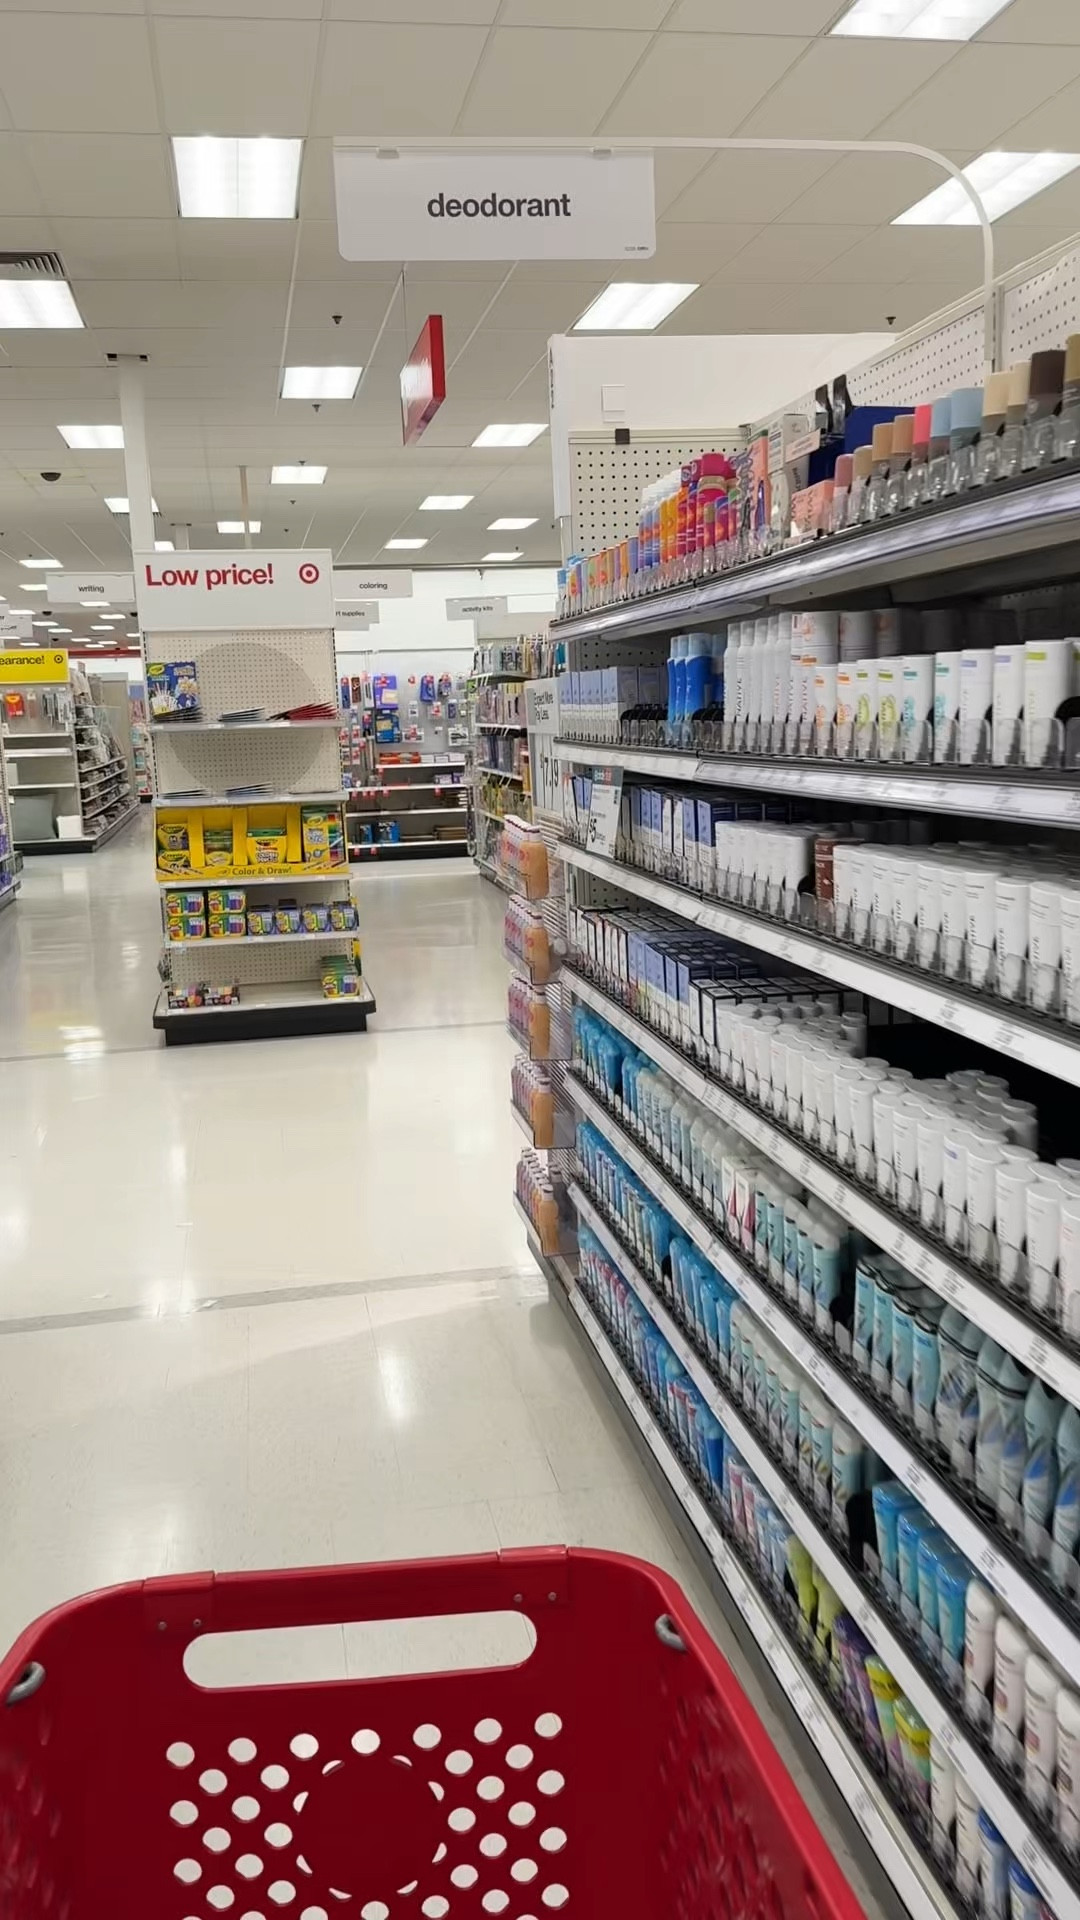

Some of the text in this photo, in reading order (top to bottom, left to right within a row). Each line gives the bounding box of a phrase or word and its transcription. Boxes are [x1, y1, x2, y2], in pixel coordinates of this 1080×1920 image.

[427, 192, 571, 217] deodorant
[145, 563, 274, 590] Low price!
[78, 585, 105, 593] writing
[359, 582, 388, 590] coloring
[462, 605, 482, 613] activity
[232, 866, 292, 876] Color & Draw!
